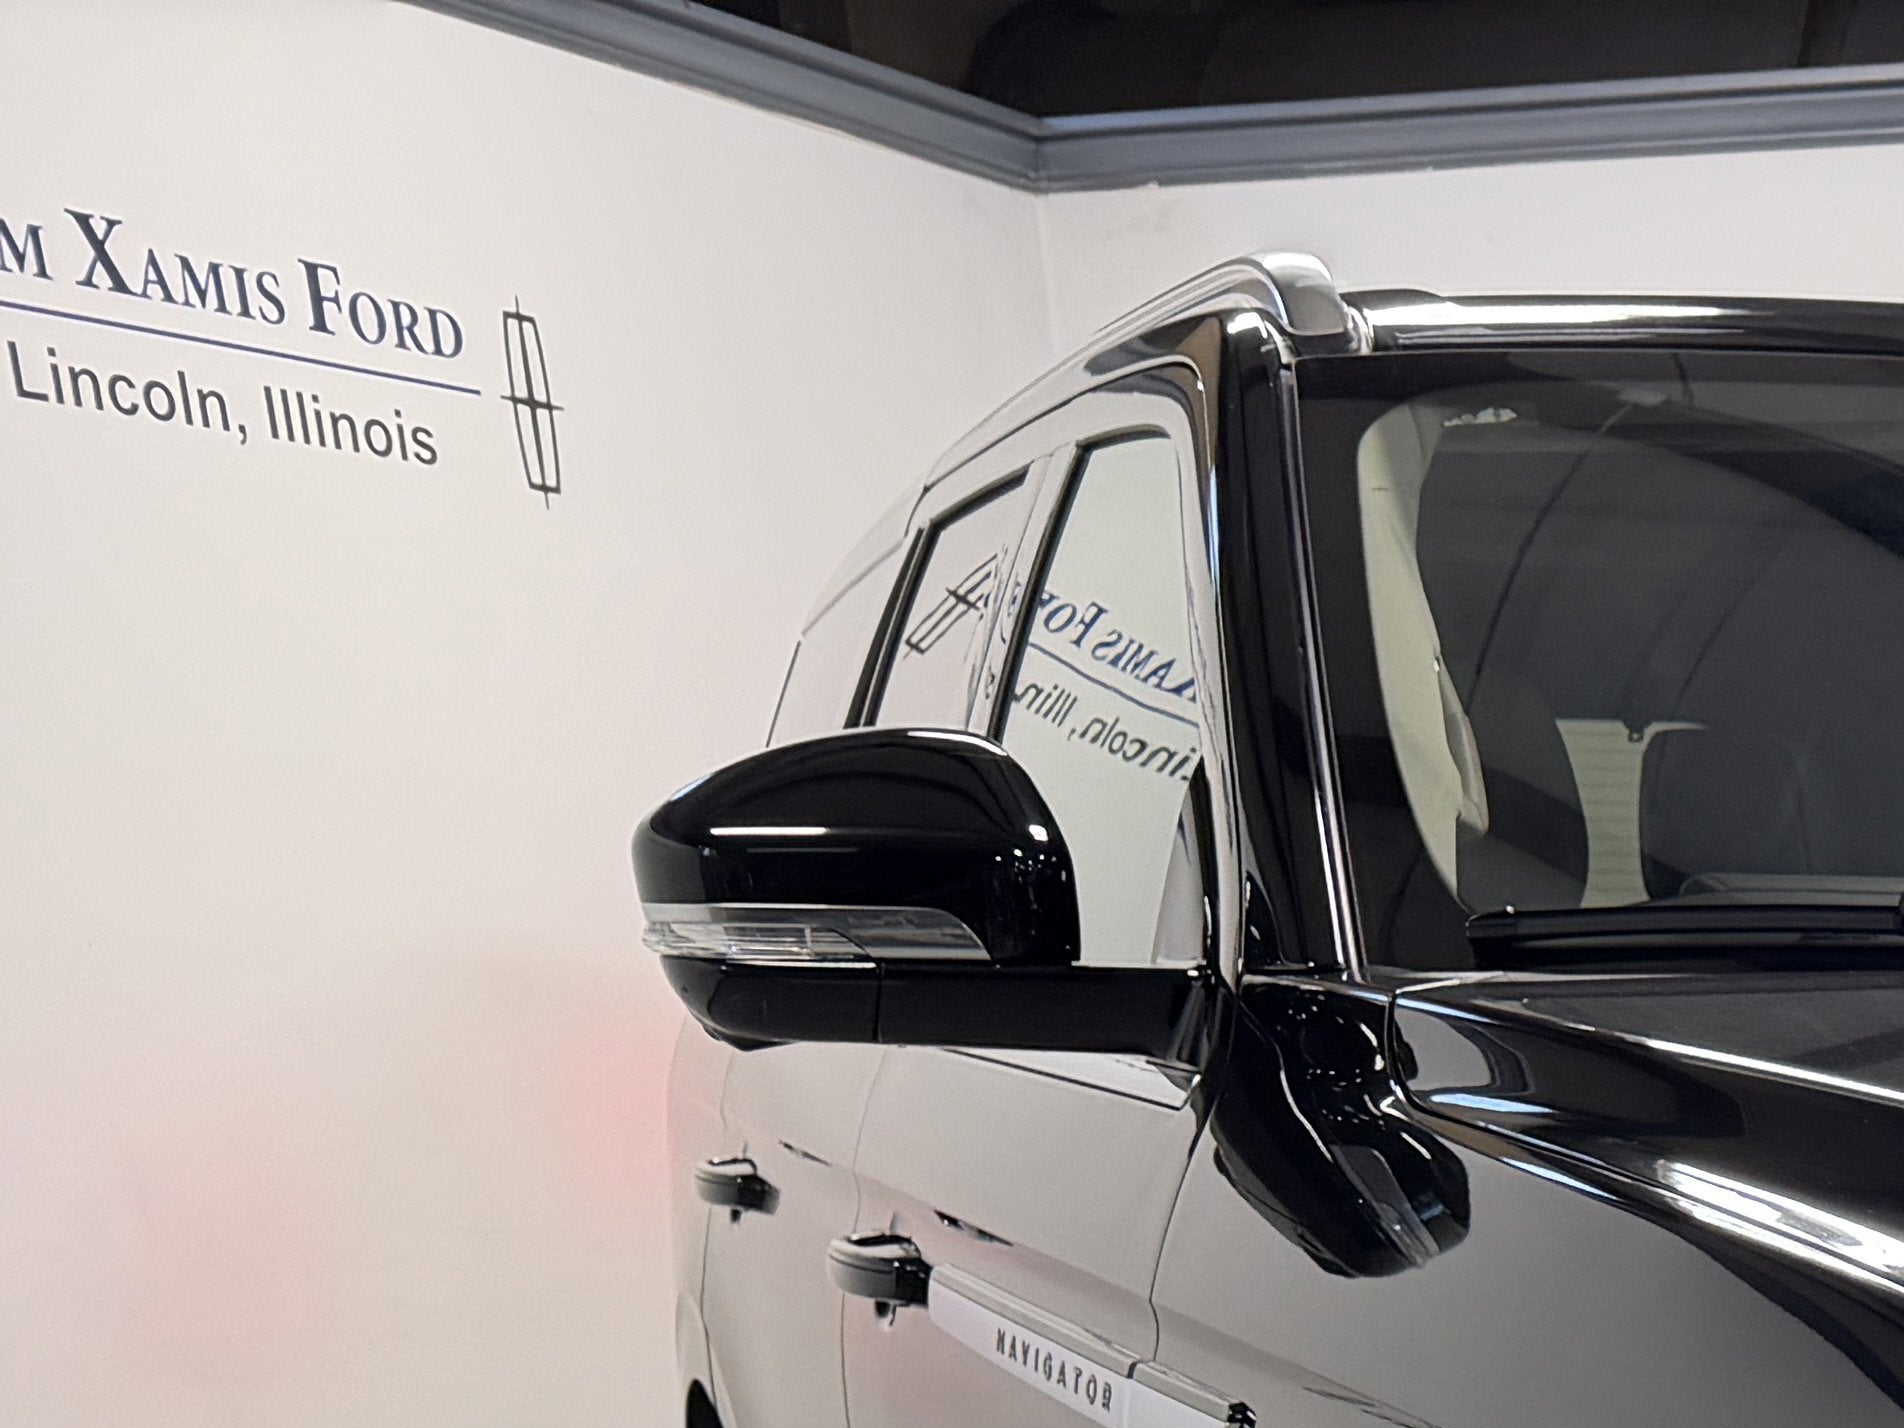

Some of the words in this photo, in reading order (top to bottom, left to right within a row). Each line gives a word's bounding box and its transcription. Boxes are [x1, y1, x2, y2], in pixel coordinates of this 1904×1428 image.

[64, 207, 286, 325] XAMIS
[297, 258, 463, 359] FORD
[7, 340, 247, 445] Lincoln,
[263, 385, 438, 466] Illinois
[996, 1328, 1113, 1412] NAVIGATOR
